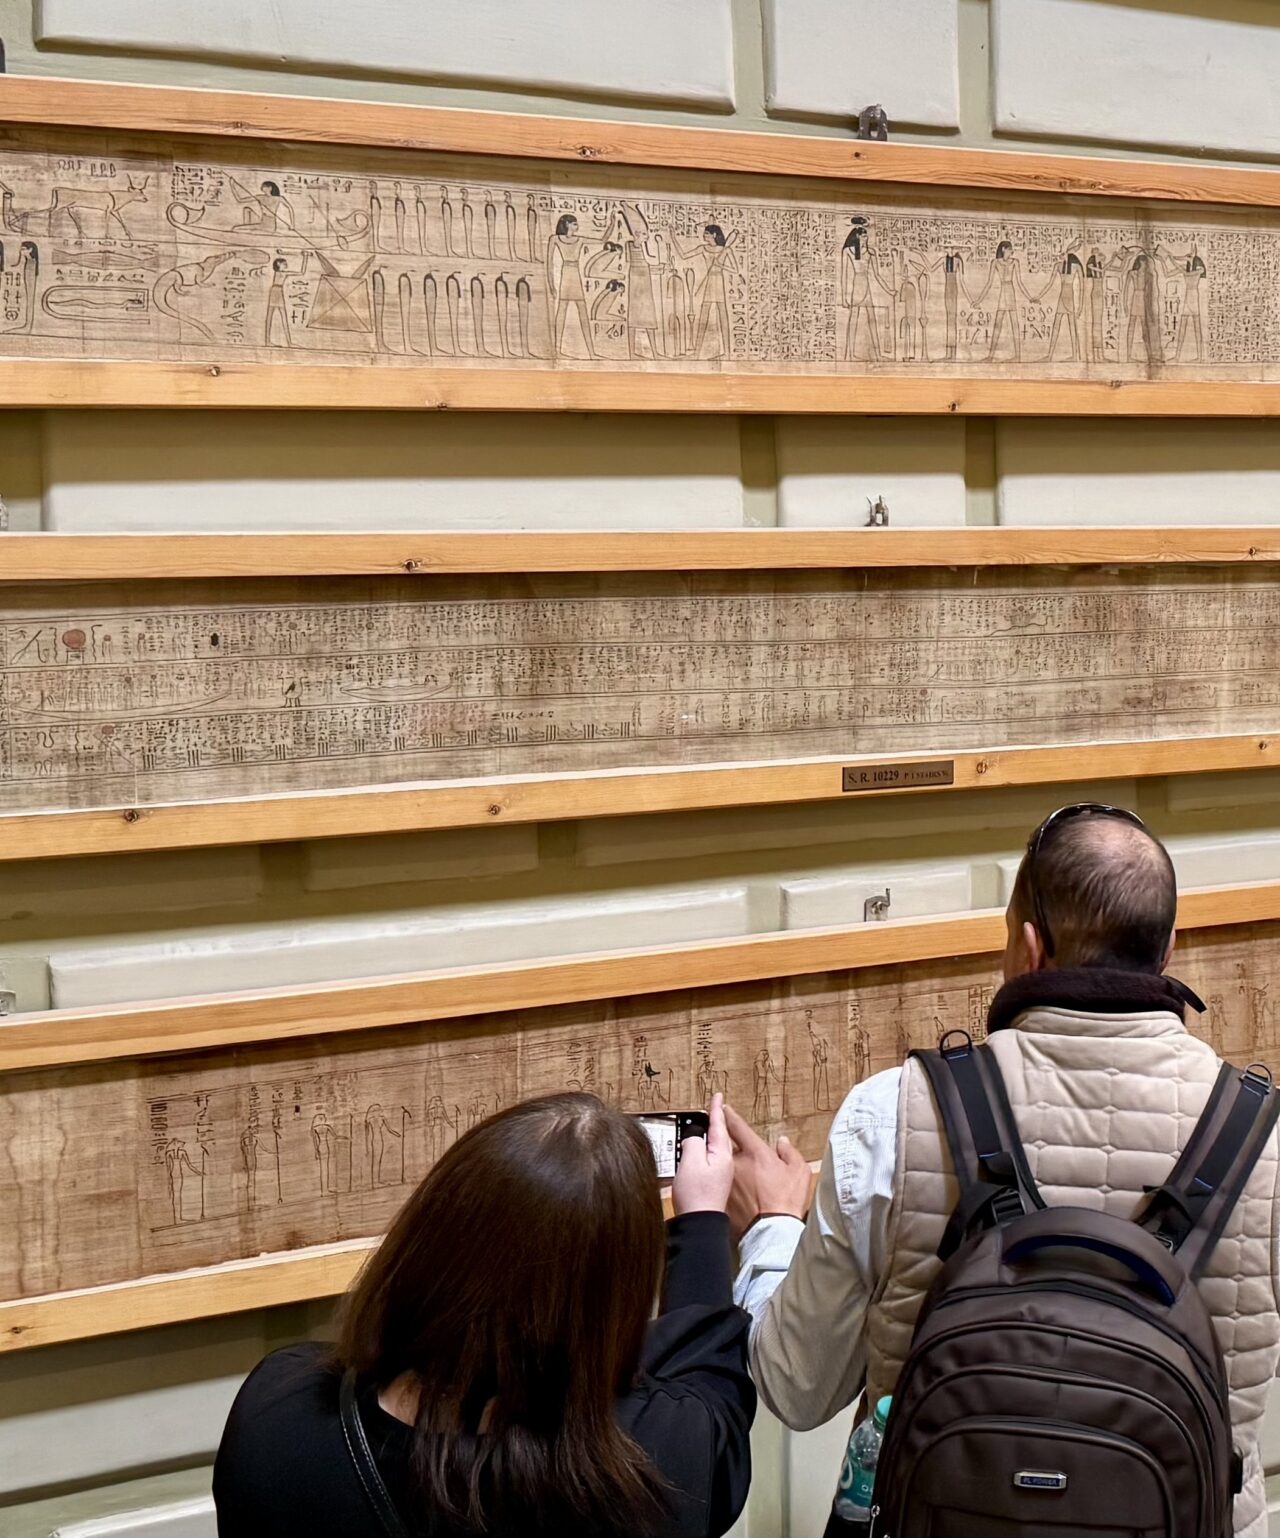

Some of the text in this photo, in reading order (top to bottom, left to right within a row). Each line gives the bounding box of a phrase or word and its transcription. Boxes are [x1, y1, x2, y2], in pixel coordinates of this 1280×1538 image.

[848, 773, 857, 783] S.
[860, 772, 870, 783] R.
[873, 770, 899, 782] 10229
